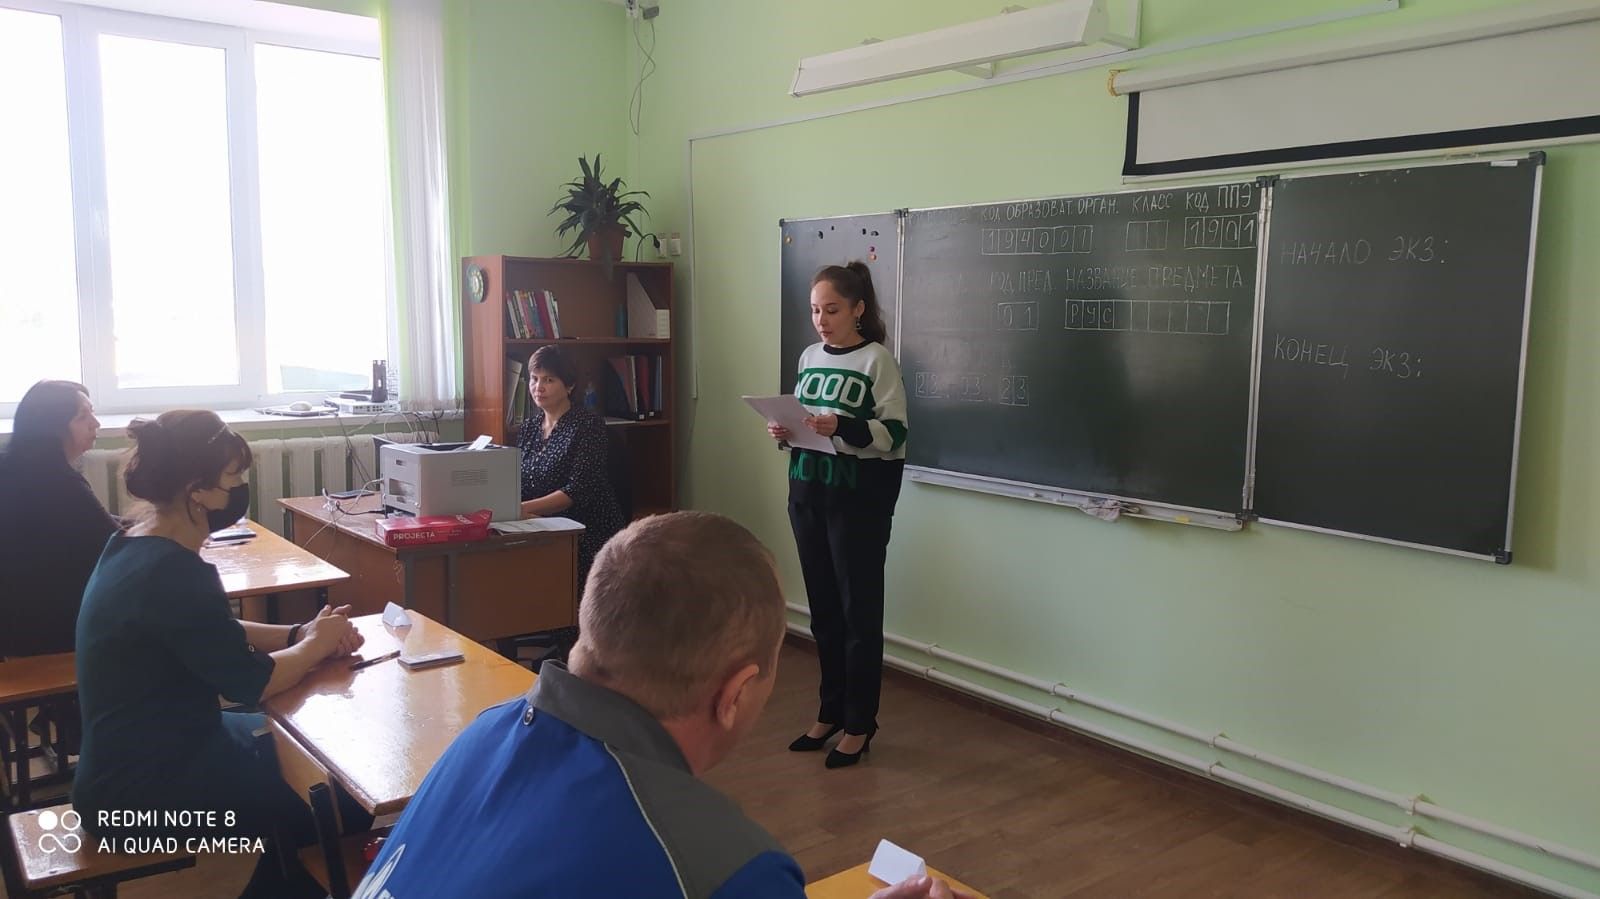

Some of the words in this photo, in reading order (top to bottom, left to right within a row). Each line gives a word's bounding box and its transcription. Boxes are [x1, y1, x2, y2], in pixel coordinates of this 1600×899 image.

[1132, 193, 1174, 214] КЛАСС
[1186, 191, 1210, 213] КОД
[1217, 183, 1253, 209] ППЭ
[1280, 239, 1372, 265] НАЧАЛО
[1066, 265, 1137, 291] НАЗВАНИЕ
[1147, 264, 1243, 292] ПРЕДМЕТА
[1274, 333, 1351, 380] КОНЕЦ
[393, 530, 436, 541] PROJECTA
